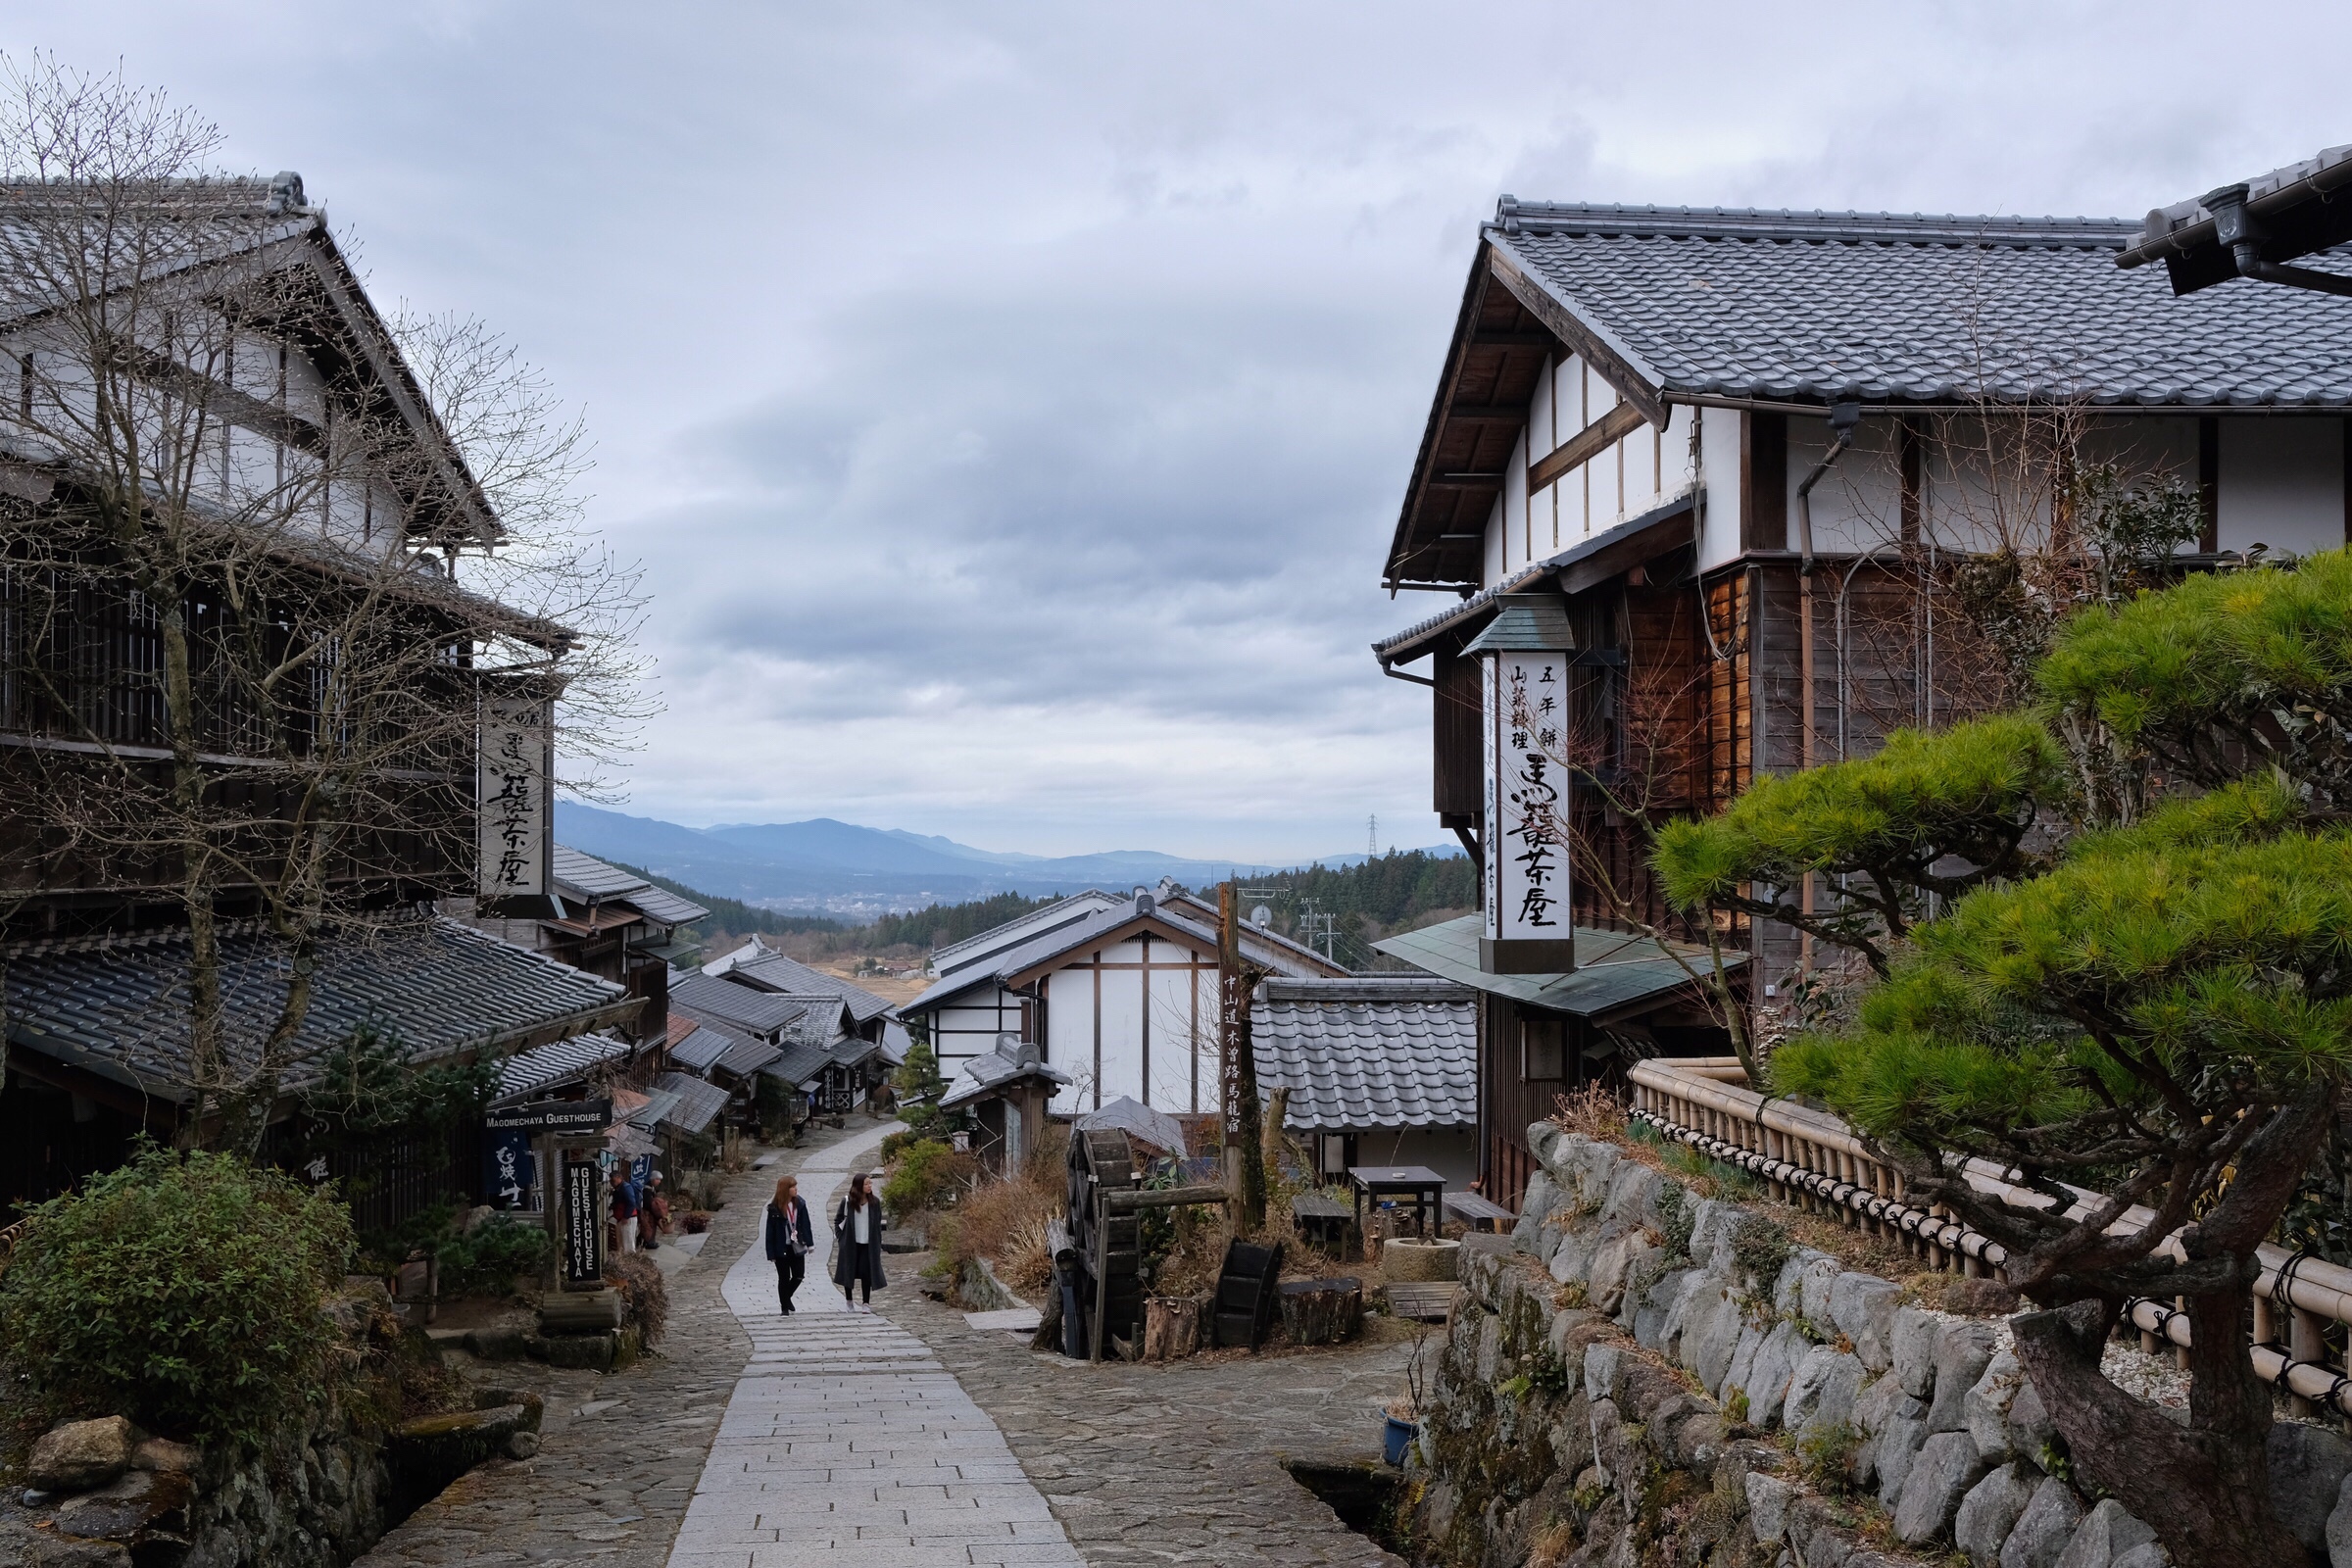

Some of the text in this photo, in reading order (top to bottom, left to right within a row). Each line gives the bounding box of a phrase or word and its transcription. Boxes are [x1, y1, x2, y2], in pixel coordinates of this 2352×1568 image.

[487, 732, 534, 886] 馬籠茶屋
[1506, 753, 1558, 926] 馬籠茶屋
[570, 1167, 583, 1278] MAGOMECHAYA
[581, 1167, 594, 1271] GUESTHOUSE
